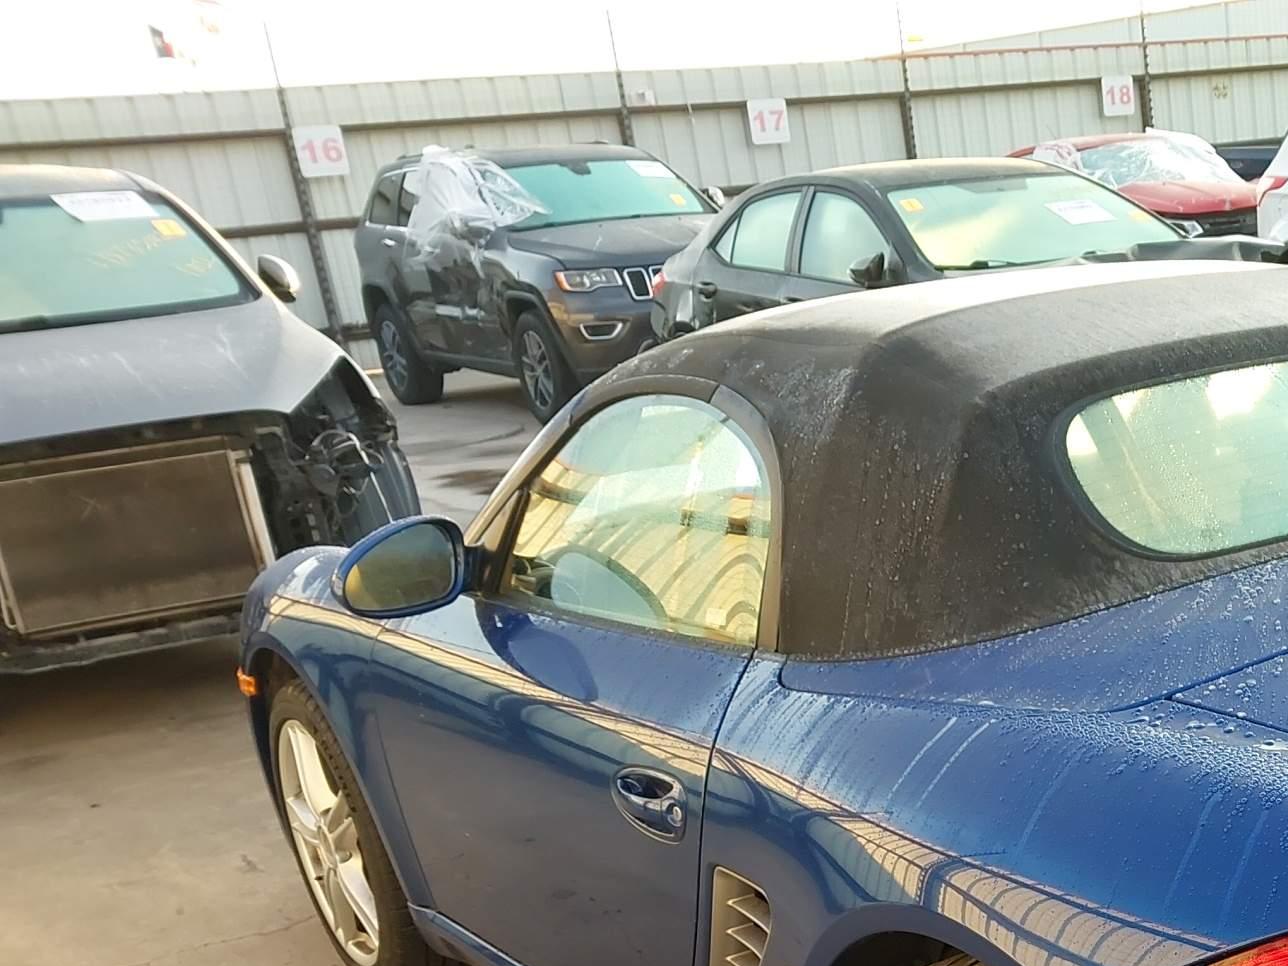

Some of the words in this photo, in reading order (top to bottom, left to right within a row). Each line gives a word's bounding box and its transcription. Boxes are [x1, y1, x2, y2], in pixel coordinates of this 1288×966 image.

[1106, 85, 1131, 105] 18
[753, 110, 784, 132] 17
[301, 138, 343, 164] 16
